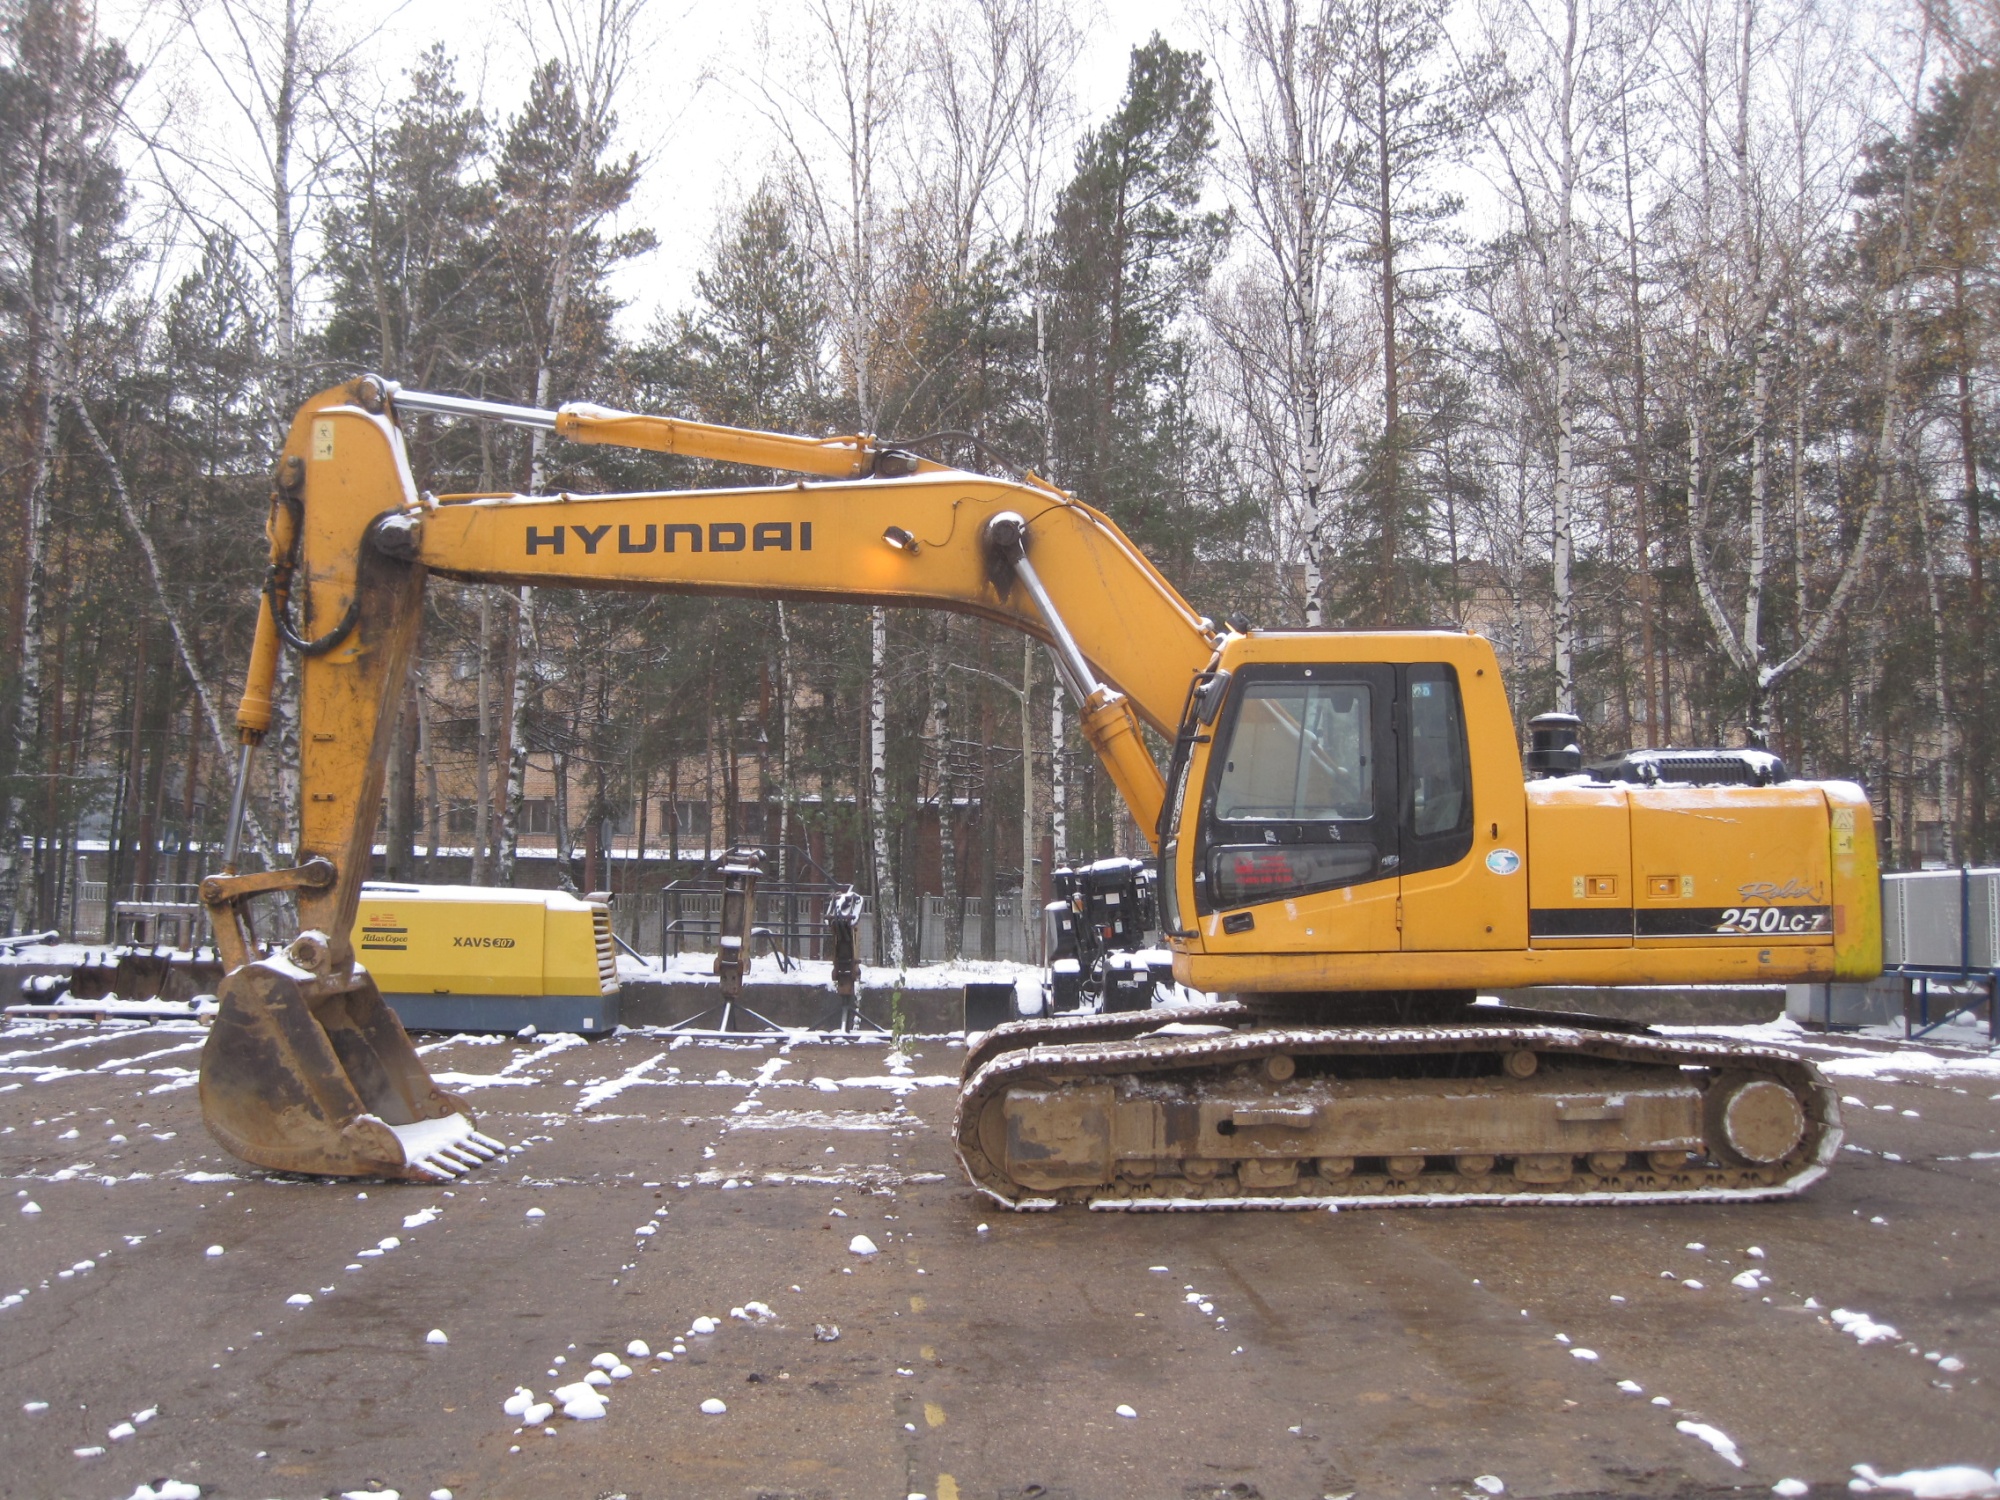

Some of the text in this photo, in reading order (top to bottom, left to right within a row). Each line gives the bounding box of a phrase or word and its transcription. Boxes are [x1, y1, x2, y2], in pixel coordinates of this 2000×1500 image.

[525, 521, 812, 556] HYUNDAI
[1737, 878, 1823, 905] Robex
[362, 934, 408, 944] Atlas Copco
